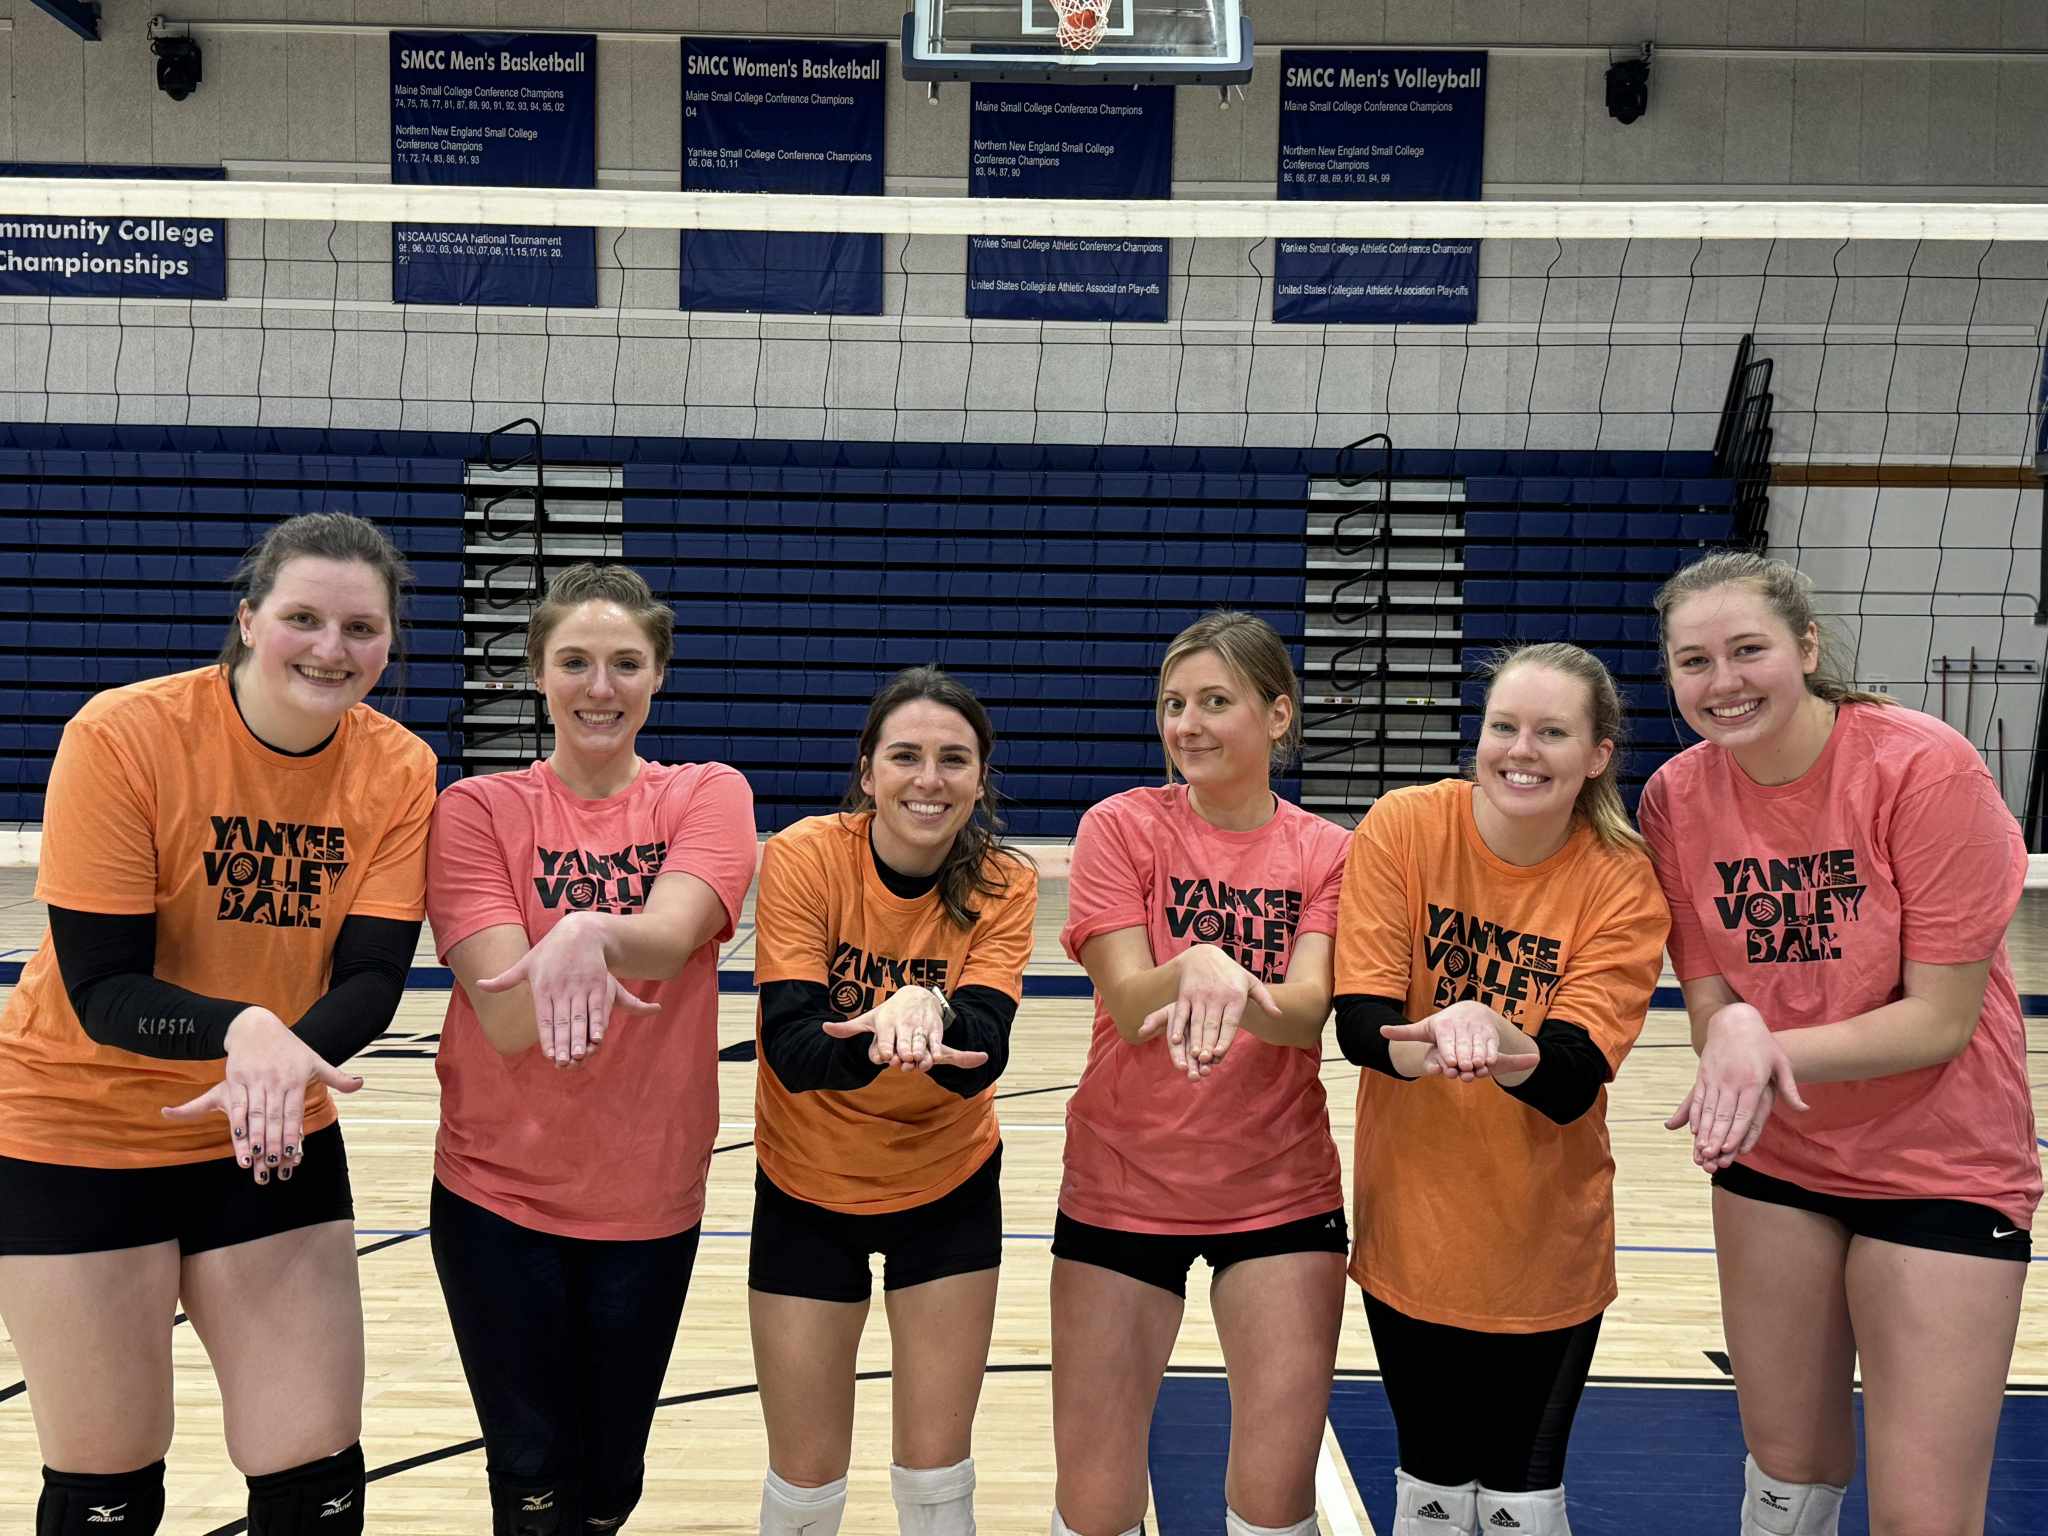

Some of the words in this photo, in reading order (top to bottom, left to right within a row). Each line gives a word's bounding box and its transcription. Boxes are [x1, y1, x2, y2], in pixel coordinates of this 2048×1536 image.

[401, 50, 445, 70] SMCC
[450, 51, 495, 71] Men's
[500, 52, 585, 72] Basketball
[688, 55, 728, 76] SMCC
[733, 57, 798, 78] Women's
[803, 59, 880, 80] Basketball
[1286, 68, 1334, 87] SMCC
[1340, 68, 1389, 88] Men's
[1394, 68, 1480, 93] Volleyball
[395, 85, 418, 96] Maine
[420, 85, 442, 96] Small
[444, 86, 472, 98] College
[474, 86, 518, 98] Conference
[520, 88, 564, 101] Champions
[686, 90, 708, 101] Maine
[712, 91, 732, 102] Small
[734, 92, 763, 105] College
[765, 93, 809, 104] Conference
[811, 94, 854, 107] Champions
[686, 107, 697, 117] 04
[976, 101, 998, 112] Maine
[1000, 102, 1022, 113] Small
[1024, 102, 1052, 115] College
[1054, 103, 1097, 114] Conference
[1100, 104, 1143, 116] Champions
[1284, 101, 1307, 112] Maine
[1310, 101, 1331, 112] Small
[1333, 101, 1362, 114] College
[1364, 102, 1408, 112] Conference
[1410, 102, 1453, 114] Champions
[396, 125, 429, 135] Northern
[431, 126, 448, 136] New
[451, 126, 482, 139] England
[485, 127, 506, 137] Small
[508, 128, 538, 140] College
[396, 138, 438, 150] Conference
[441, 140, 483, 152] Champions
[974, 140, 1007, 151] Northern
[1009, 141, 1026, 151] New
[1029, 142, 1060, 154] England
[1062, 142, 1083, 152] Small
[1085, 143, 1114, 155] College
[1283, 145, 1316, 156] Northern
[1318, 146, 1335, 156] New
[1338, 146, 1369, 158] England
[1371, 146, 1392, 156] Small
[1395, 146, 1424, 158] College
[688, 148, 717, 158] Yankee
[720, 148, 742, 159] Small
[744, 149, 775, 161] College
[777, 150, 824, 161] Conference
[826, 151, 872, 162] Champions
[974, 154, 1016, 165] Conference
[1018, 155, 1060, 168] Champions
[1283, 159, 1325, 170] Conference
[1327, 160, 1369, 172] Champions
[118, 220, 214, 247] College
[471, 233, 507, 244] National
[509, 234, 562, 246] Tournament
[973, 238, 999, 249] Yankee
[1001, 239, 1021, 249] Small
[1023, 239, 1050, 252] College
[1052, 240, 1078, 251] Athletic
[1080, 241, 1120, 252] Conference
[1123, 242, 1163, 254] Champions
[1280, 243, 1307, 253] Yankee
[1309, 243, 1330, 253] Small
[1332, 243, 1359, 256] College
[1361, 243, 1387, 253] Athletic
[1389, 244, 1430, 254] Conference
[1432, 244, 1472, 256] Champions
[971, 280, 994, 290] United
[996, 280, 1019, 291] States
[1020, 281, 1056, 293] Collegiate
[1058, 282, 1084, 292] Athletic
[1086, 283, 1127, 294] Association
[1128, 284, 1159, 296] Play-offs
[1279, 284, 1301, 294] United
[1304, 285, 1326, 295] States
[1328, 285, 1364, 297] Collegiate
[1366, 285, 1392, 295] Athletic
[1394, 286, 1435, 296] Association
[1437, 286, 1468, 297] Play-offs
[210, 816, 344, 860] YANKEE
[202, 851, 350, 895] VOLLEY
[533, 875, 657, 908] VOLL
[1170, 875, 1302, 924] YANKEE
[217, 887, 321, 928] BALL
[1713, 885, 1867, 929] VOLLEY
[1428, 903, 1562, 972] YANKEE
[1746, 925, 1842, 964] BALL
[1424, 935, 1562, 1006] VOLLEY
[138, 1017, 196, 1035] KIPSTA
[1417, 1509, 1450, 1520] adidas
[1490, 1518, 1520, 1528] adidas
